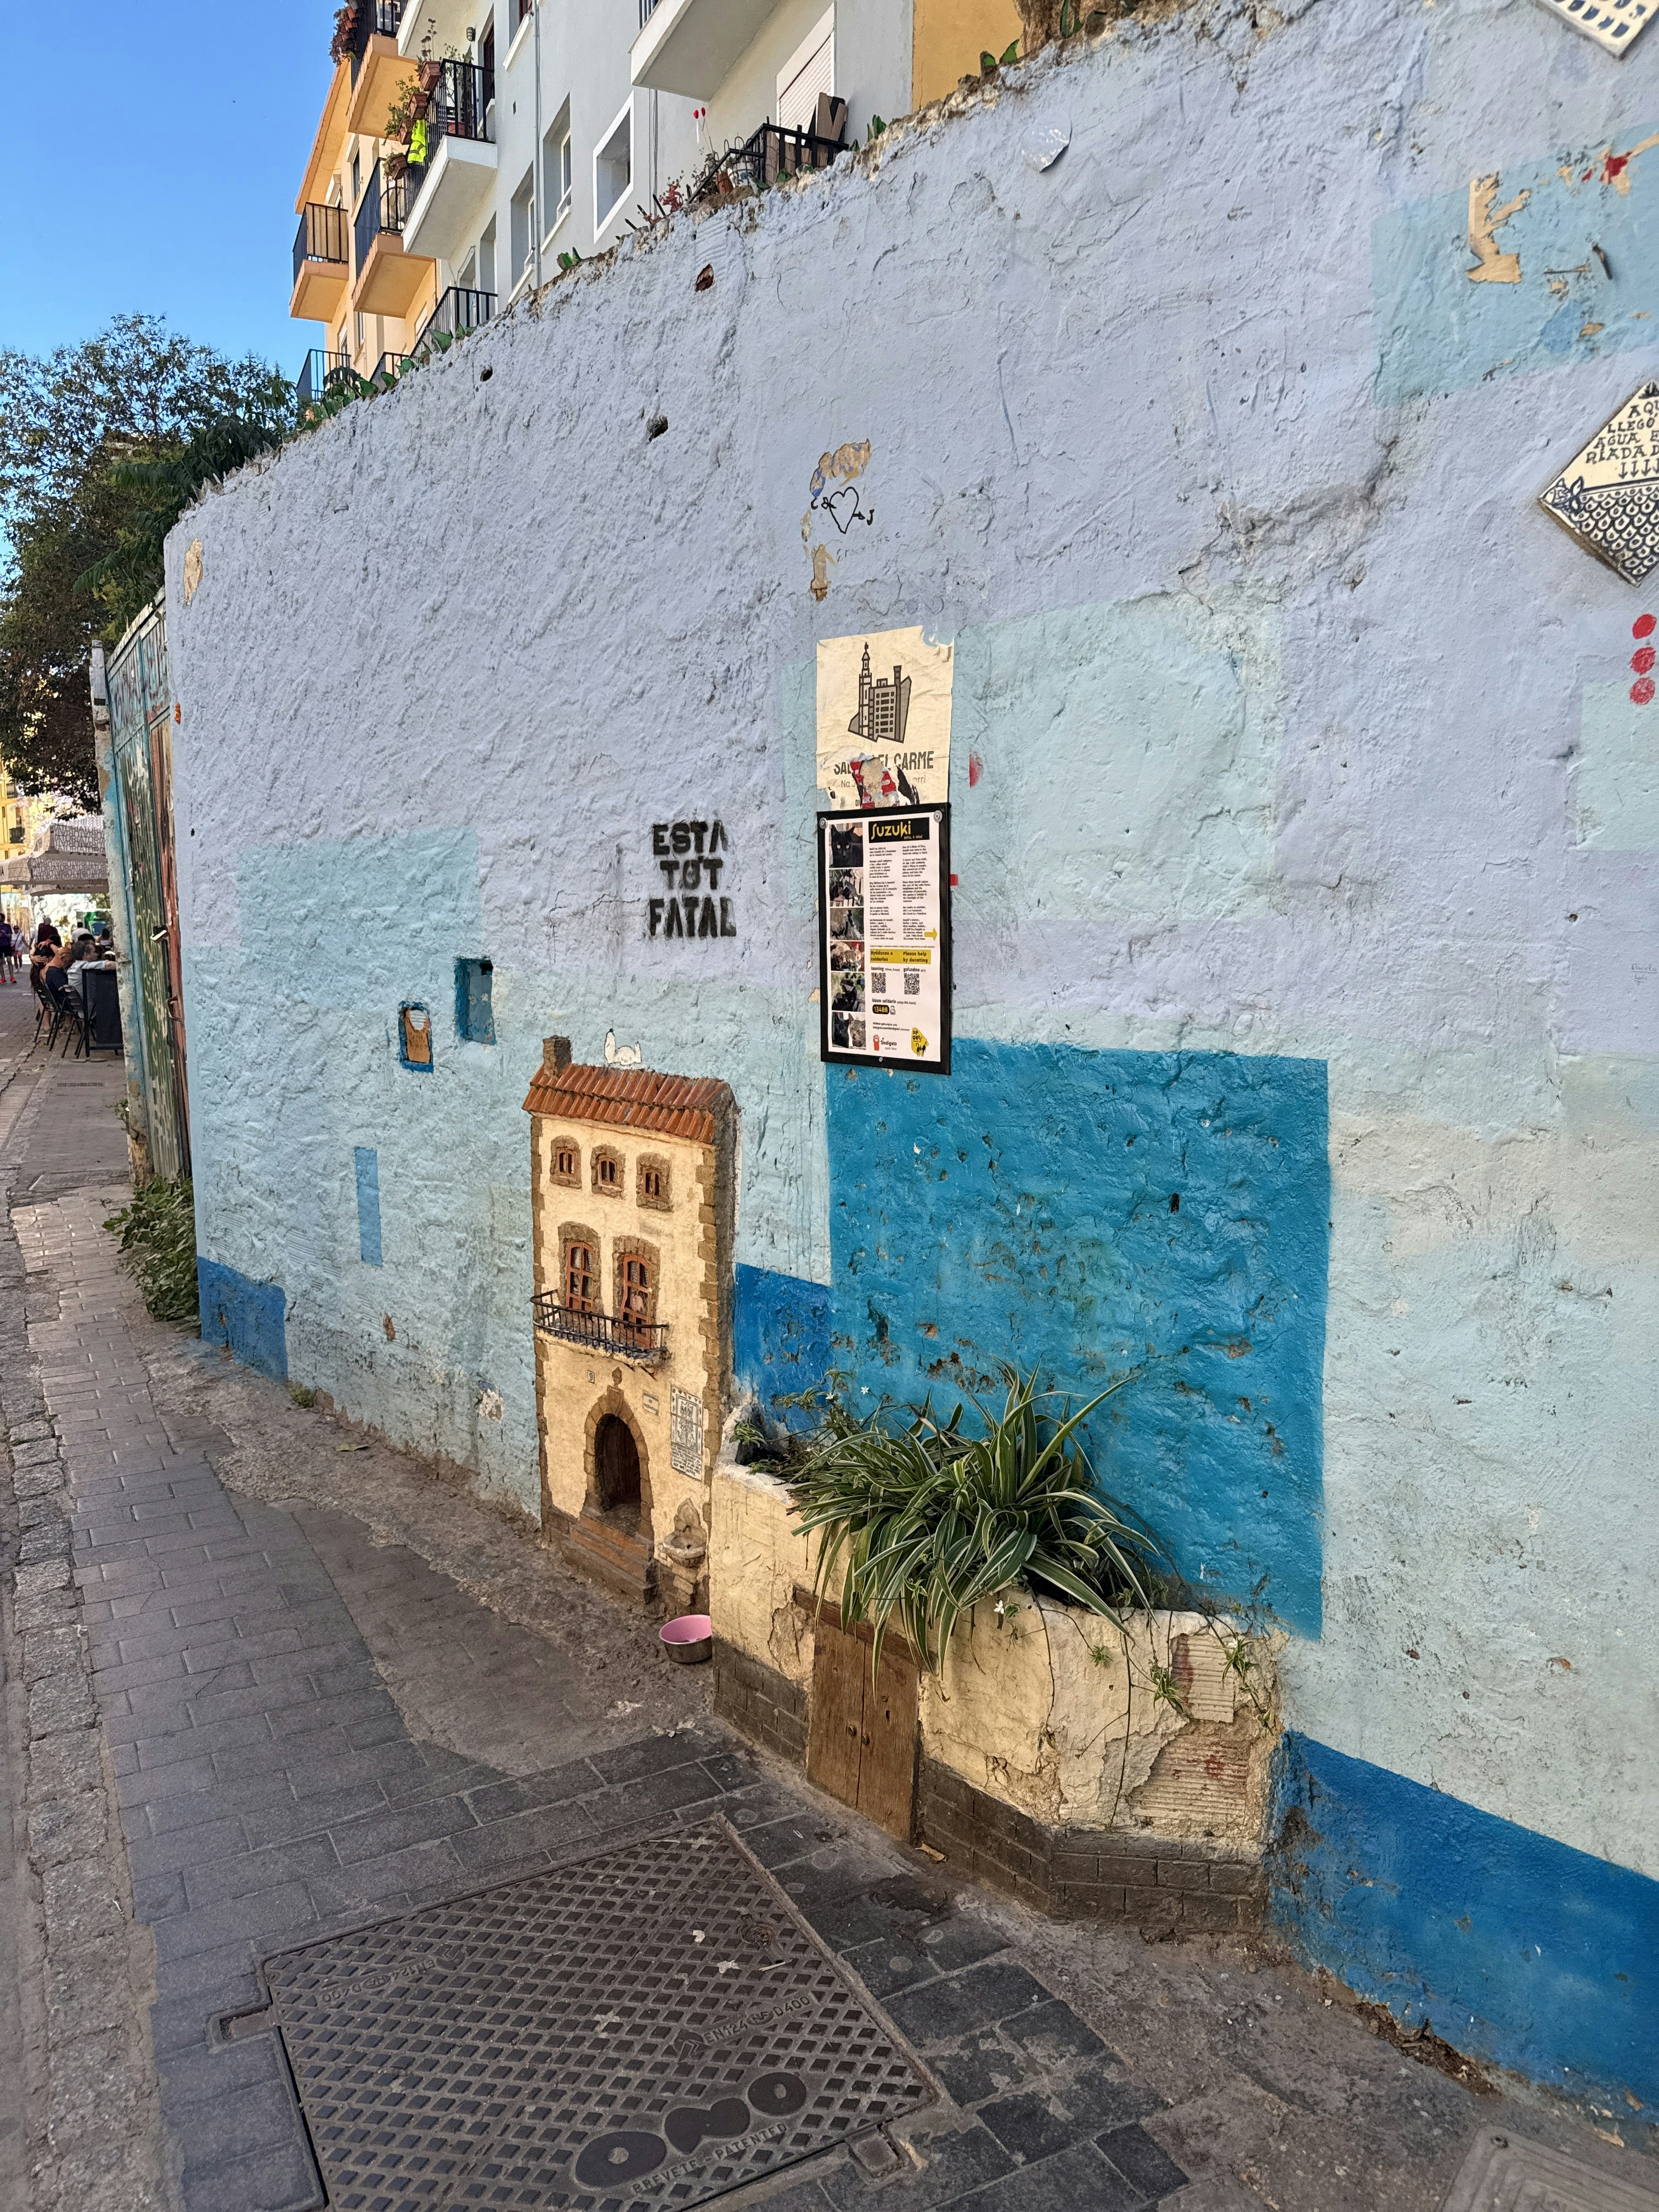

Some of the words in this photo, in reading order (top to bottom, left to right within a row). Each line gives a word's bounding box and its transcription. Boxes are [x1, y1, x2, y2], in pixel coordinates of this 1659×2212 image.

[1593, 432, 1641, 450] AGUA
[1585, 444, 1647, 464] RIADA
[894, 751, 934, 770] CARME
[871, 820, 912, 840] Suzuki
[660, 857, 724, 890] TOT
[650, 896, 736, 938] FATAL
[714, 2123, 787, 2160] PATENTED
